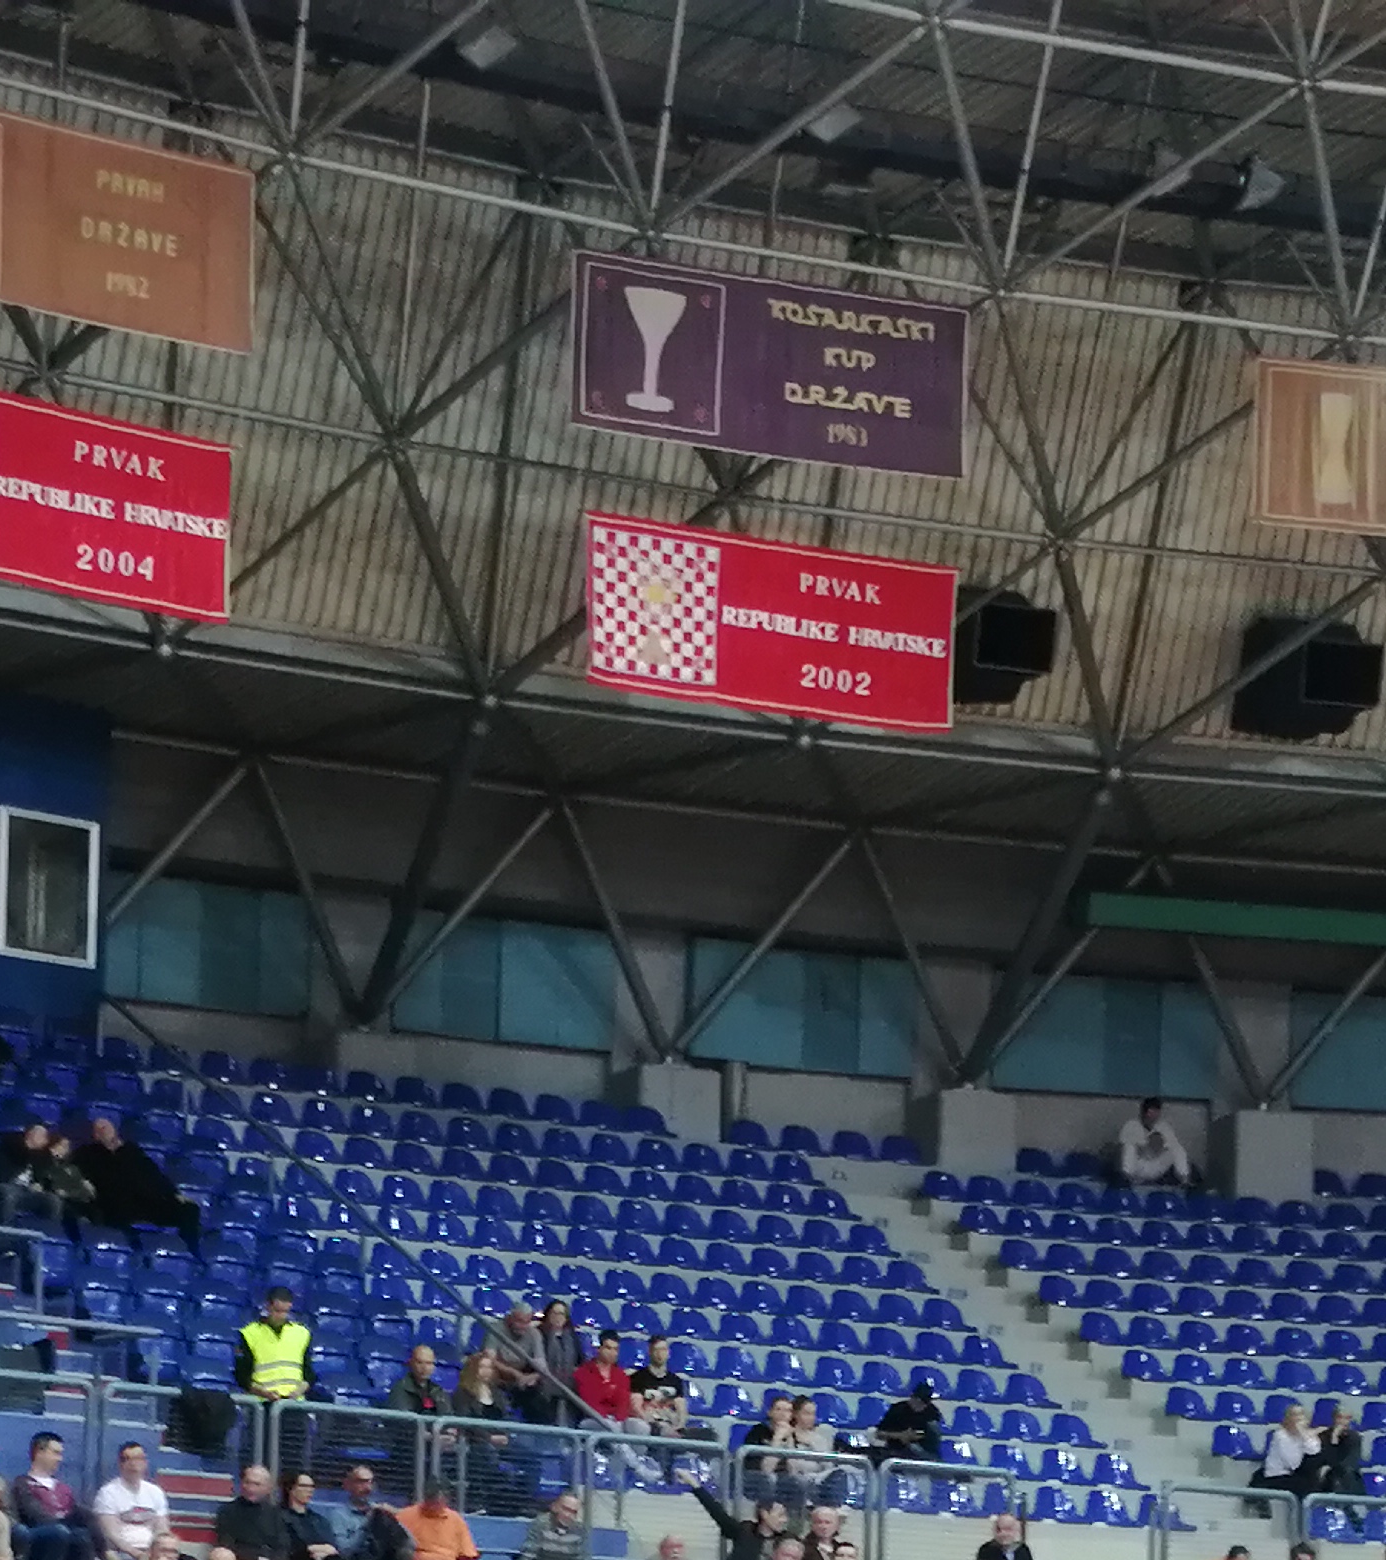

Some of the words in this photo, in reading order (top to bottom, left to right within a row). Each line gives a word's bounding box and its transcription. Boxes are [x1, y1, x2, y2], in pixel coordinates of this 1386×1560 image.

[824, 347, 876, 372] KUP
[73, 440, 168, 482] PRVAK
[124, 502, 229, 540] HRVATSKE
[76, 543, 155, 582] 2004
[799, 572, 882, 605] PRVAK
[721, 604, 840, 644] REPUBLIKE
[848, 625, 947, 659] HRVATSKE
[800, 663, 873, 697] 2002
